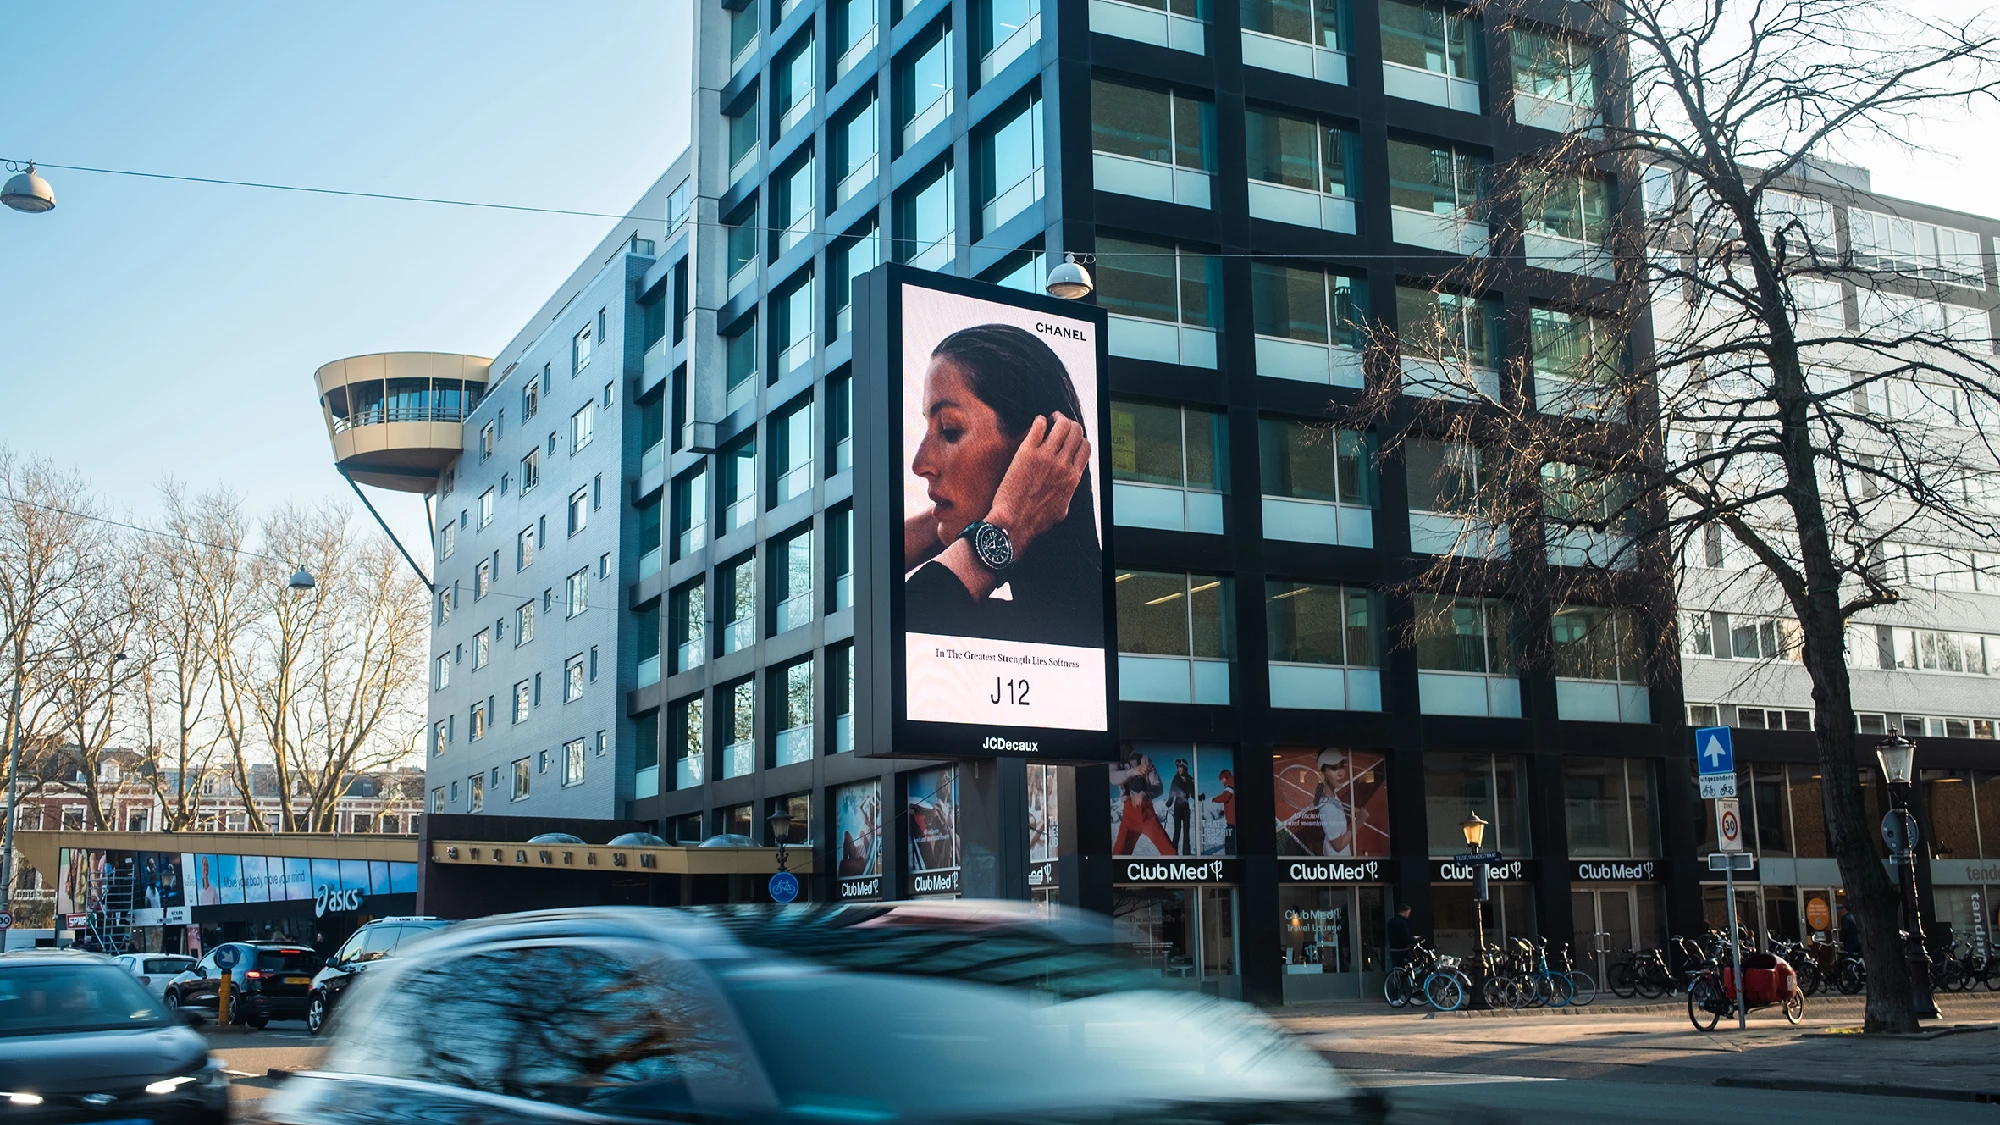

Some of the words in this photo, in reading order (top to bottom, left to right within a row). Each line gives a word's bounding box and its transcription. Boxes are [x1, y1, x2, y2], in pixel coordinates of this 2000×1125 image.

[1036, 321, 1087, 341] CHANEL
[935, 648, 945, 658] In
[946, 649, 963, 660] The
[963, 651, 996, 662] Greatest
[997, 653, 1031, 665] Strength
[1032, 656, 1048, 666] Lies
[1048, 657, 1080, 668] Softness
[982, 736, 1039, 752] JCDecaux
[1725, 820, 1735, 832] 30
[224, 876, 237, 888] Move
[291, 870, 306, 883] mind
[1287, 923, 1310, 932] Travel
[1312, 924, 1342, 933] Lounge
